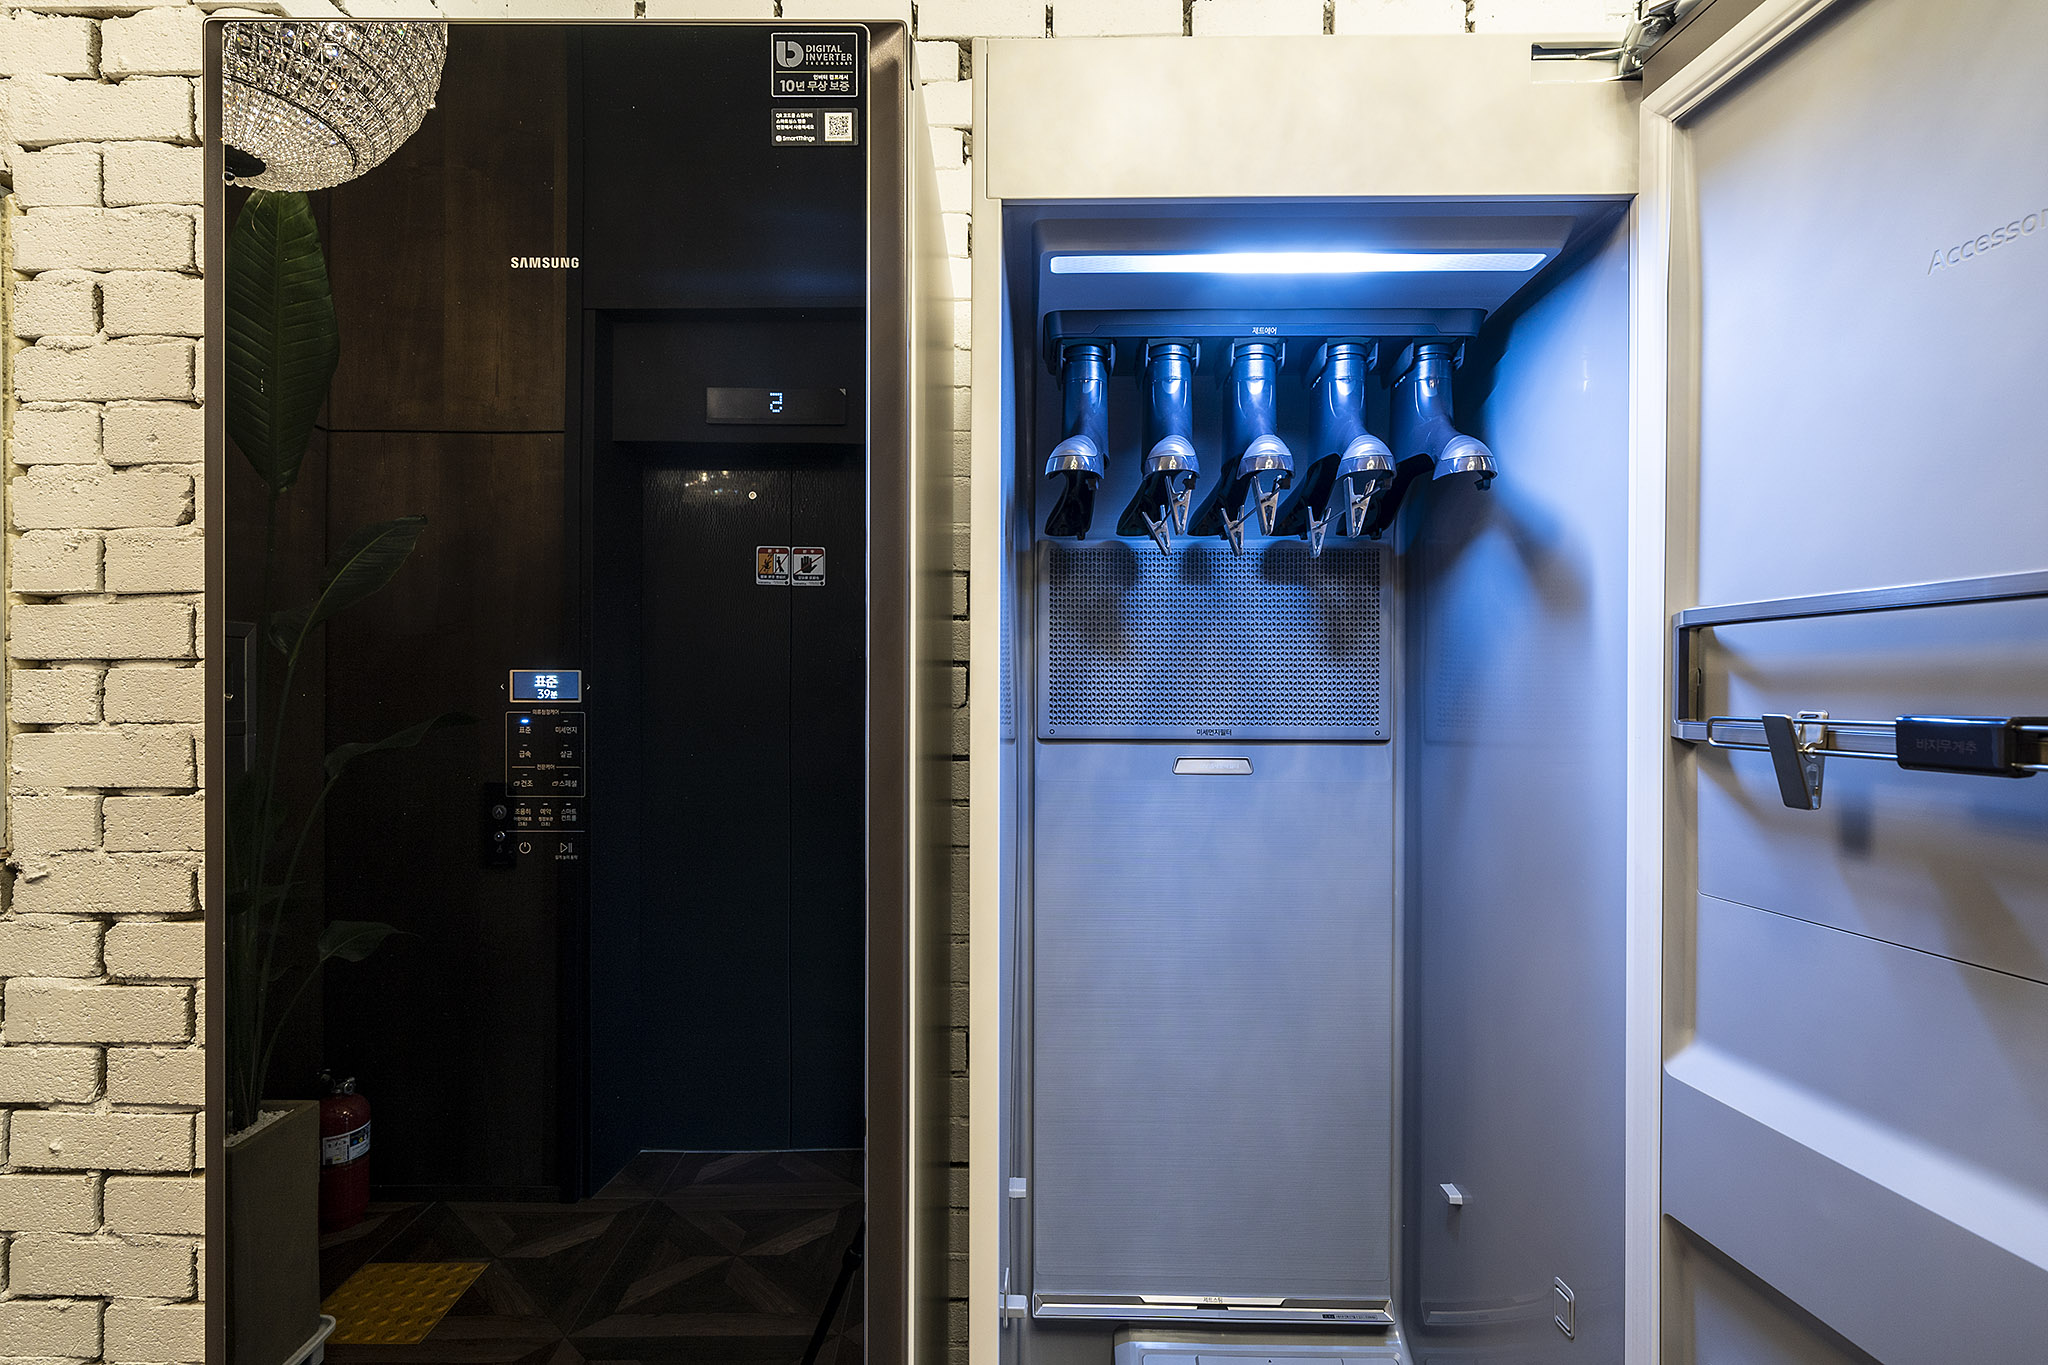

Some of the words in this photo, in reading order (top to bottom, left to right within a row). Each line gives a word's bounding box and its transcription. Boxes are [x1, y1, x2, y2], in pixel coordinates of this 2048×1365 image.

[805, 45, 843, 53] DIGITAL
[805, 53, 853, 61] INVERTER
[780, 80, 805, 92] 10년
[807, 81, 828, 92] 무상
[829, 81, 850, 92] 보증
[510, 256, 580, 269] SAMSUNG
[1252, 326, 1278, 335] 제트에어
[533, 675, 559, 689] 표준
[537, 688, 558, 699] 39분
[518, 726, 532, 734] 표준
[554, 726, 578, 735] 미세먼지
[1196, 728, 1232, 736] 미세먼지필터
[1916, 738, 1977, 755] 바지무게추
[518, 750, 532, 758] 급속
[560, 750, 573, 758] 살균
[520, 779, 534, 788] 건조
[558, 779, 578, 788] 스페셜
[514, 808, 532, 816] 조용히
